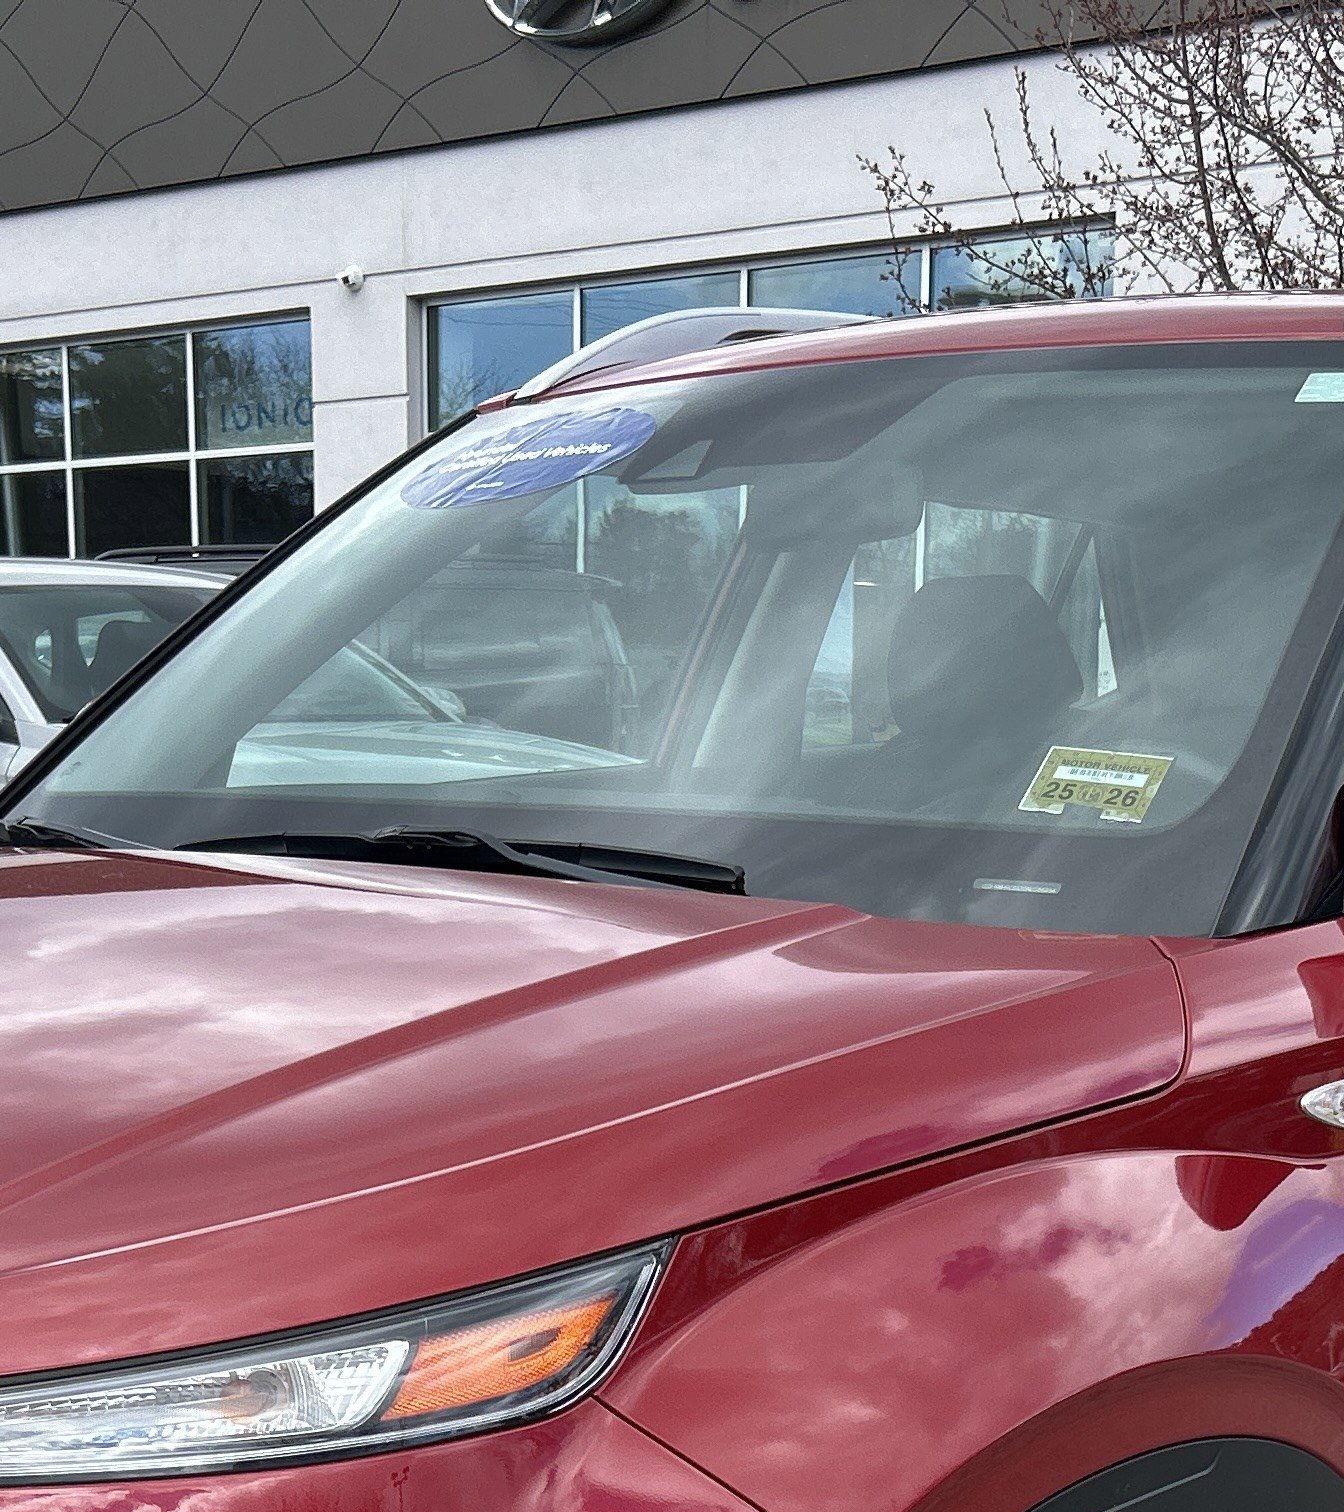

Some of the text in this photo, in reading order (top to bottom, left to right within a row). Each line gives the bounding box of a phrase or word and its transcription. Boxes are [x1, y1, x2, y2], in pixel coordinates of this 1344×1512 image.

[1061, 758, 1102, 769] MOTOR
[1104, 763, 1153, 775] VEHICLE
[1040, 780, 1078, 801] 25
[1102, 787, 1140, 808] 26
